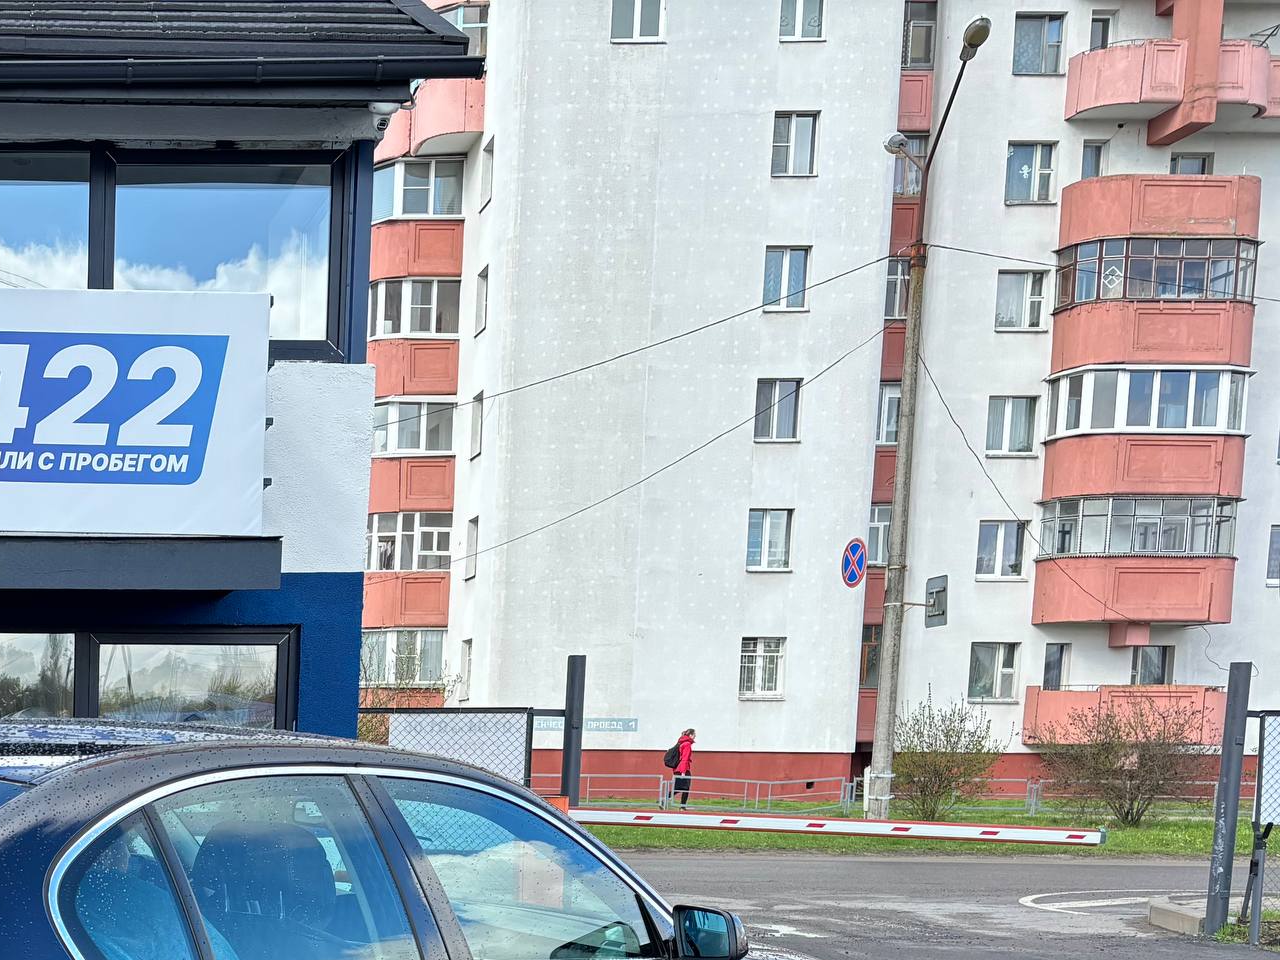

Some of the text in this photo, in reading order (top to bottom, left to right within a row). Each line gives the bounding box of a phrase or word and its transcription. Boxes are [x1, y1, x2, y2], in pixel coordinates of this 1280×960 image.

[38, 452, 54, 470] С
[59, 453, 189, 473] ПРОБЕГОМ
[587, 720, 623, 729] ПРОЕЗД
